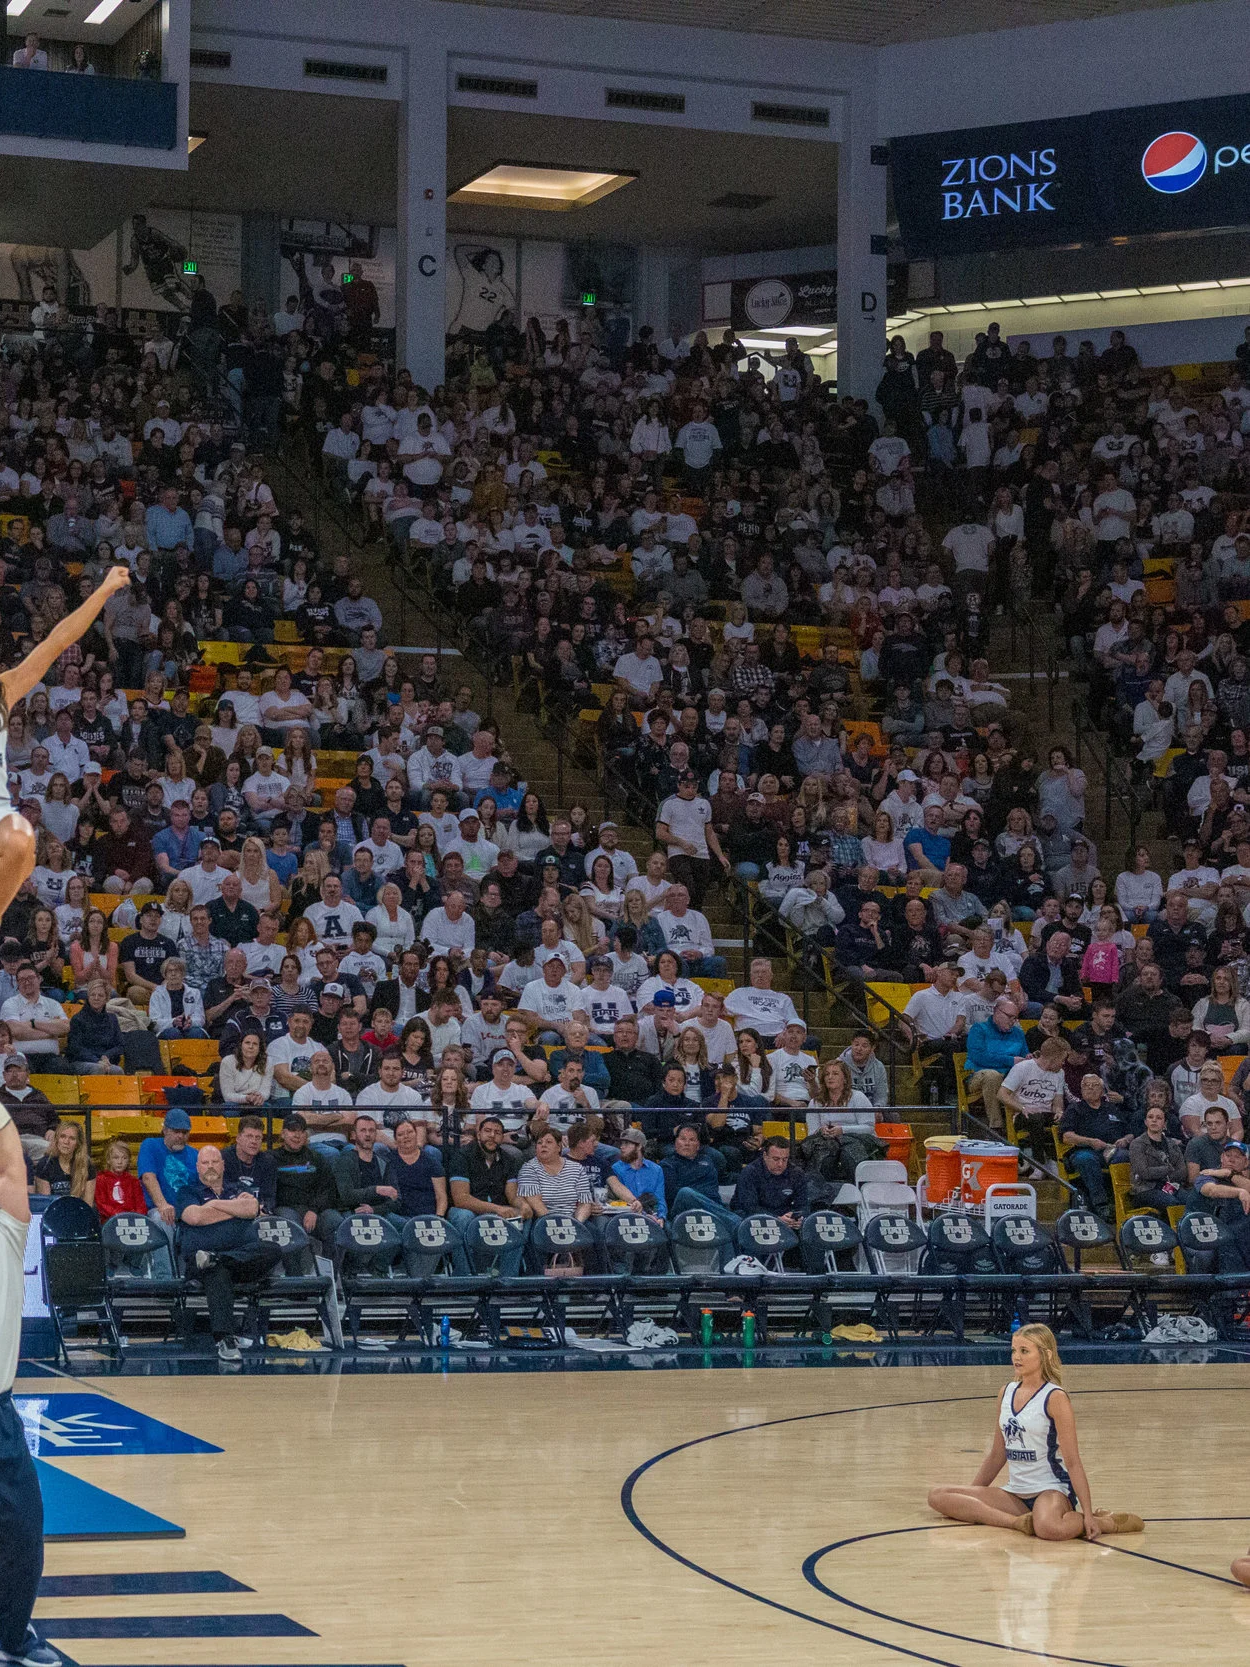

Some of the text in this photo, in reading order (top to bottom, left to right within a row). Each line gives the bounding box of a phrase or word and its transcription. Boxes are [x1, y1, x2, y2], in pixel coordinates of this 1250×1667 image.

[941, 148, 1057, 186] ZIONS
[941, 182, 1056, 220] BANK
[418, 254, 437, 277] C
[479, 287, 498, 304] 22
[861, 292, 877, 313] D
[773, 872, 802, 883] Aggies
[322, 915, 347, 938] A
[591, 1009, 619, 1017] STATE
[1020, 1087, 1046, 1099] Turbo
[1012, 1450, 1036, 1461] STATE
